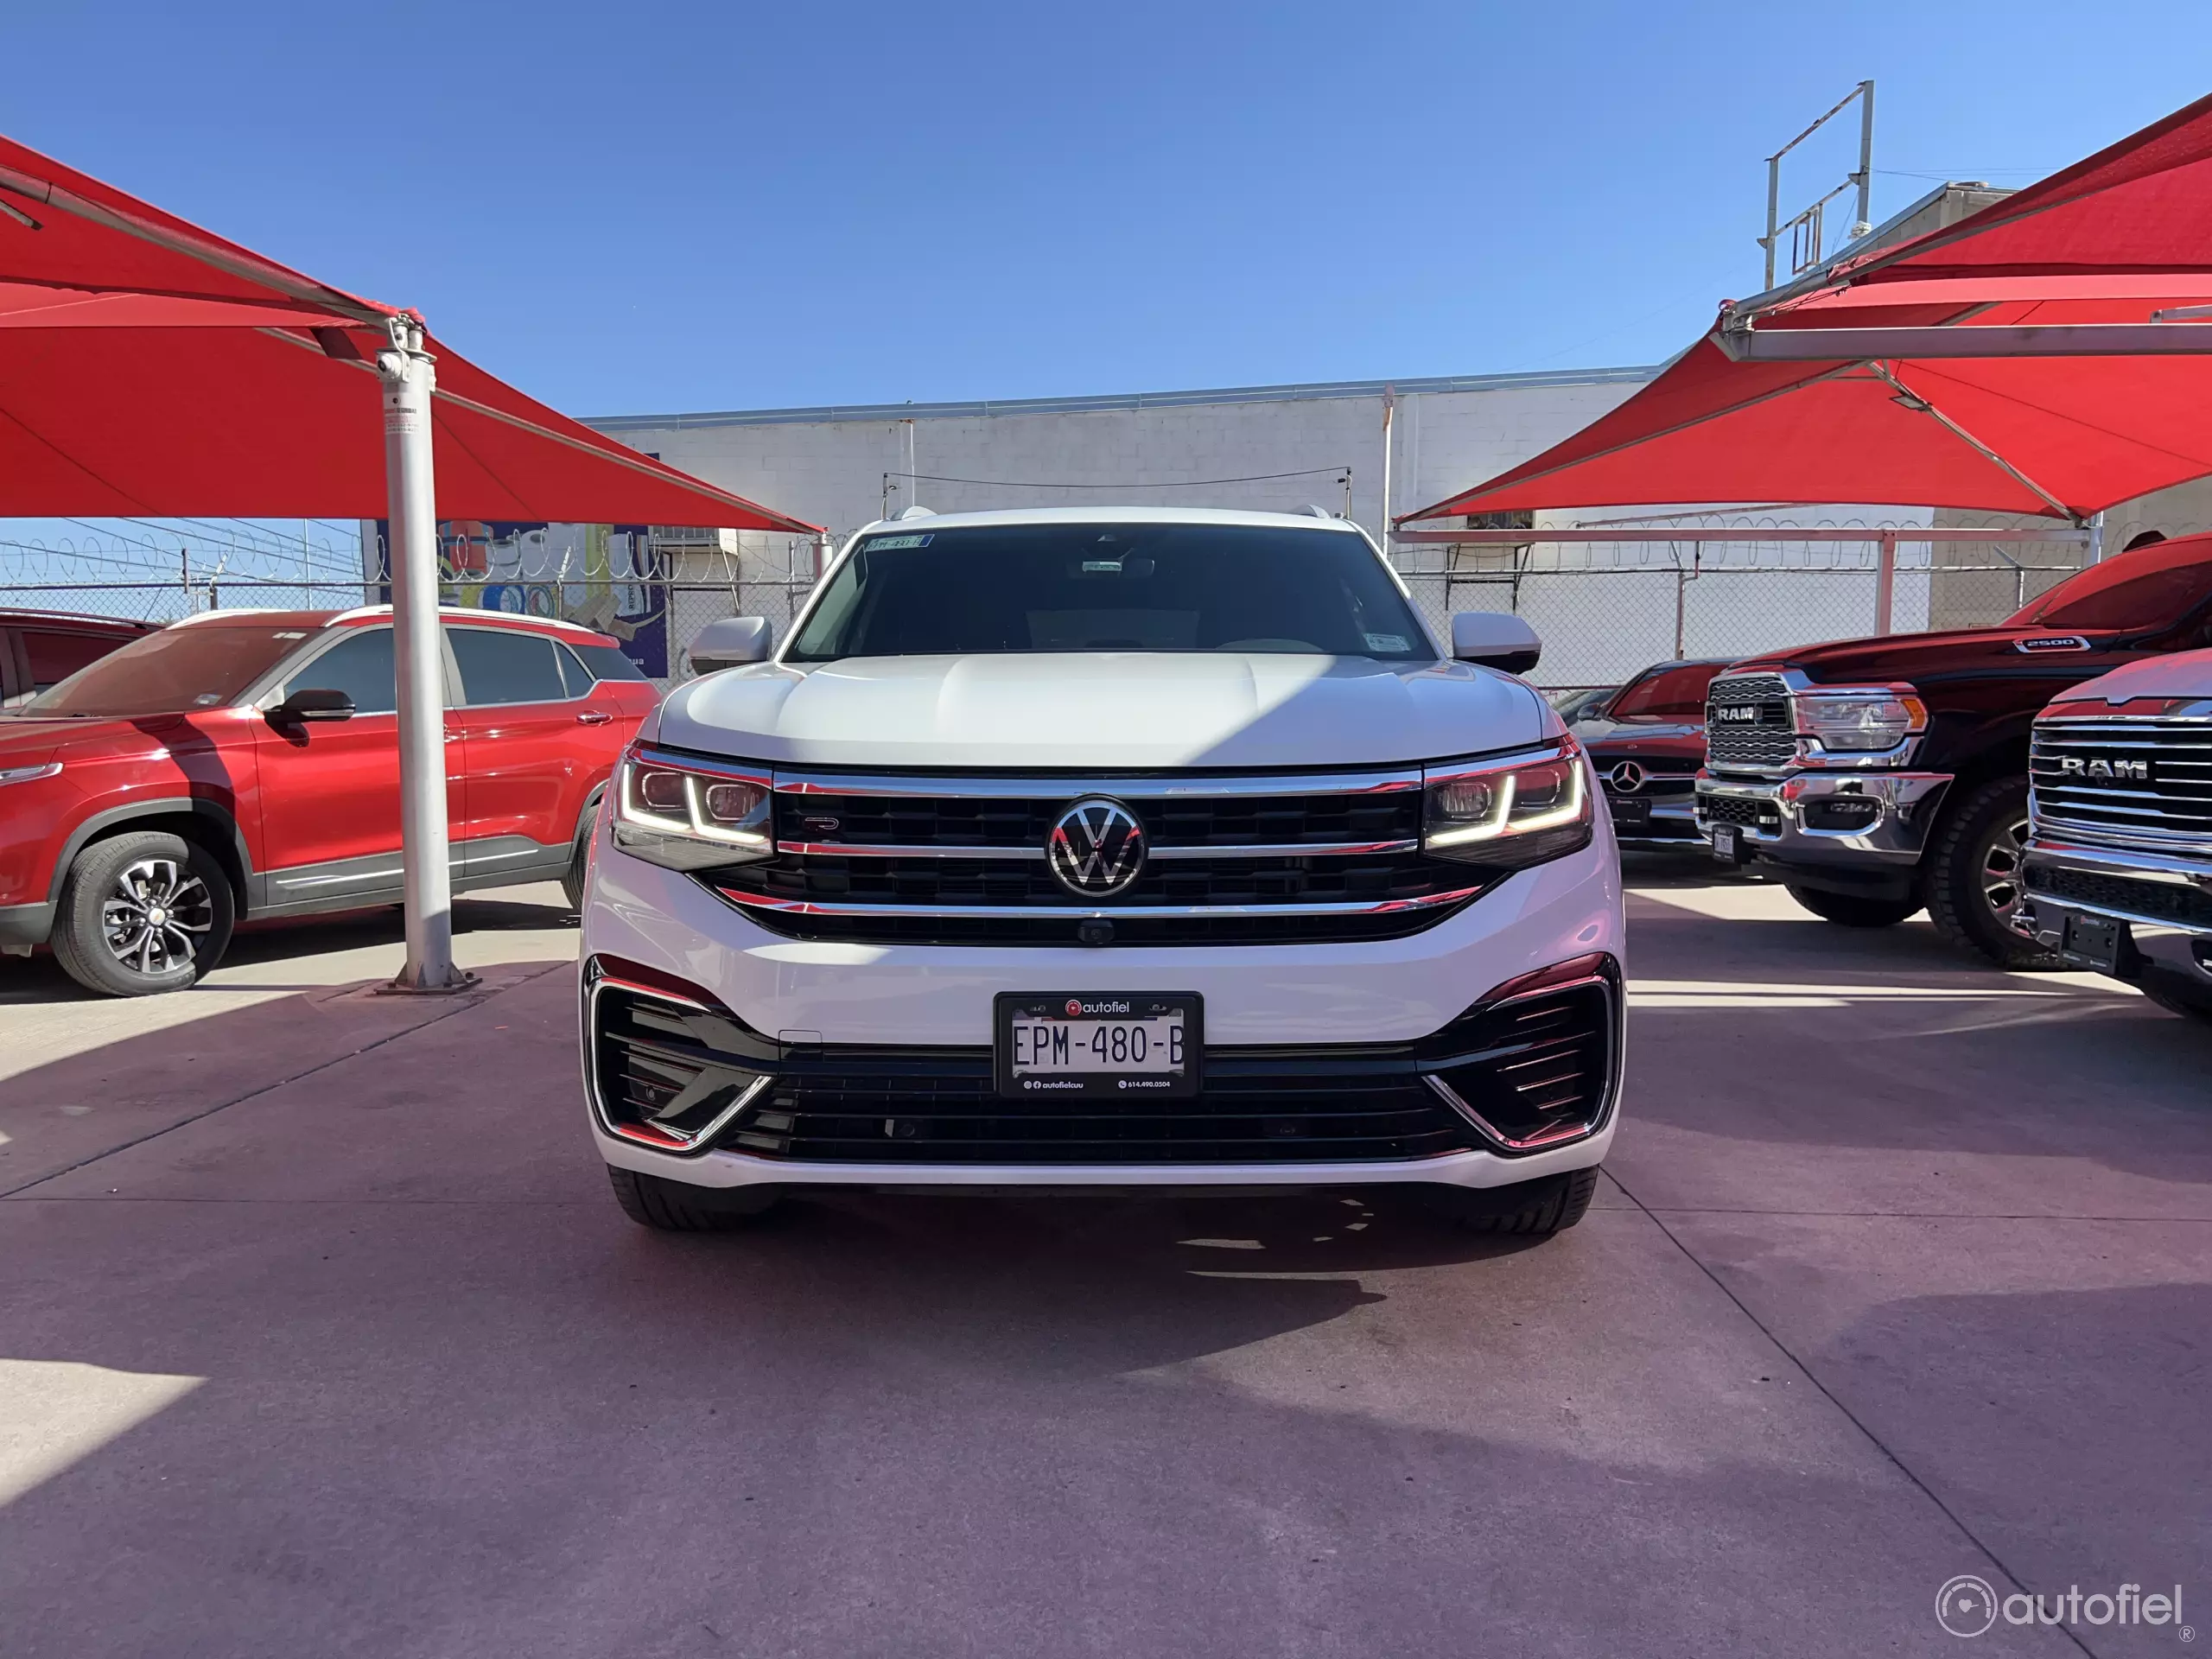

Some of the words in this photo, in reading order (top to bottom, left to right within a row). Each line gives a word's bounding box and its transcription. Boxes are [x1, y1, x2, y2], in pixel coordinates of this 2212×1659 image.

[1718, 707, 1754, 721] RAM
[2062, 759, 2147, 779] RAM
[1082, 1001, 1130, 1014] autofiel
[1013, 1025, 1185, 1066] EPM-480-B
[1042, 1081, 1084, 1090] autofielcuu
